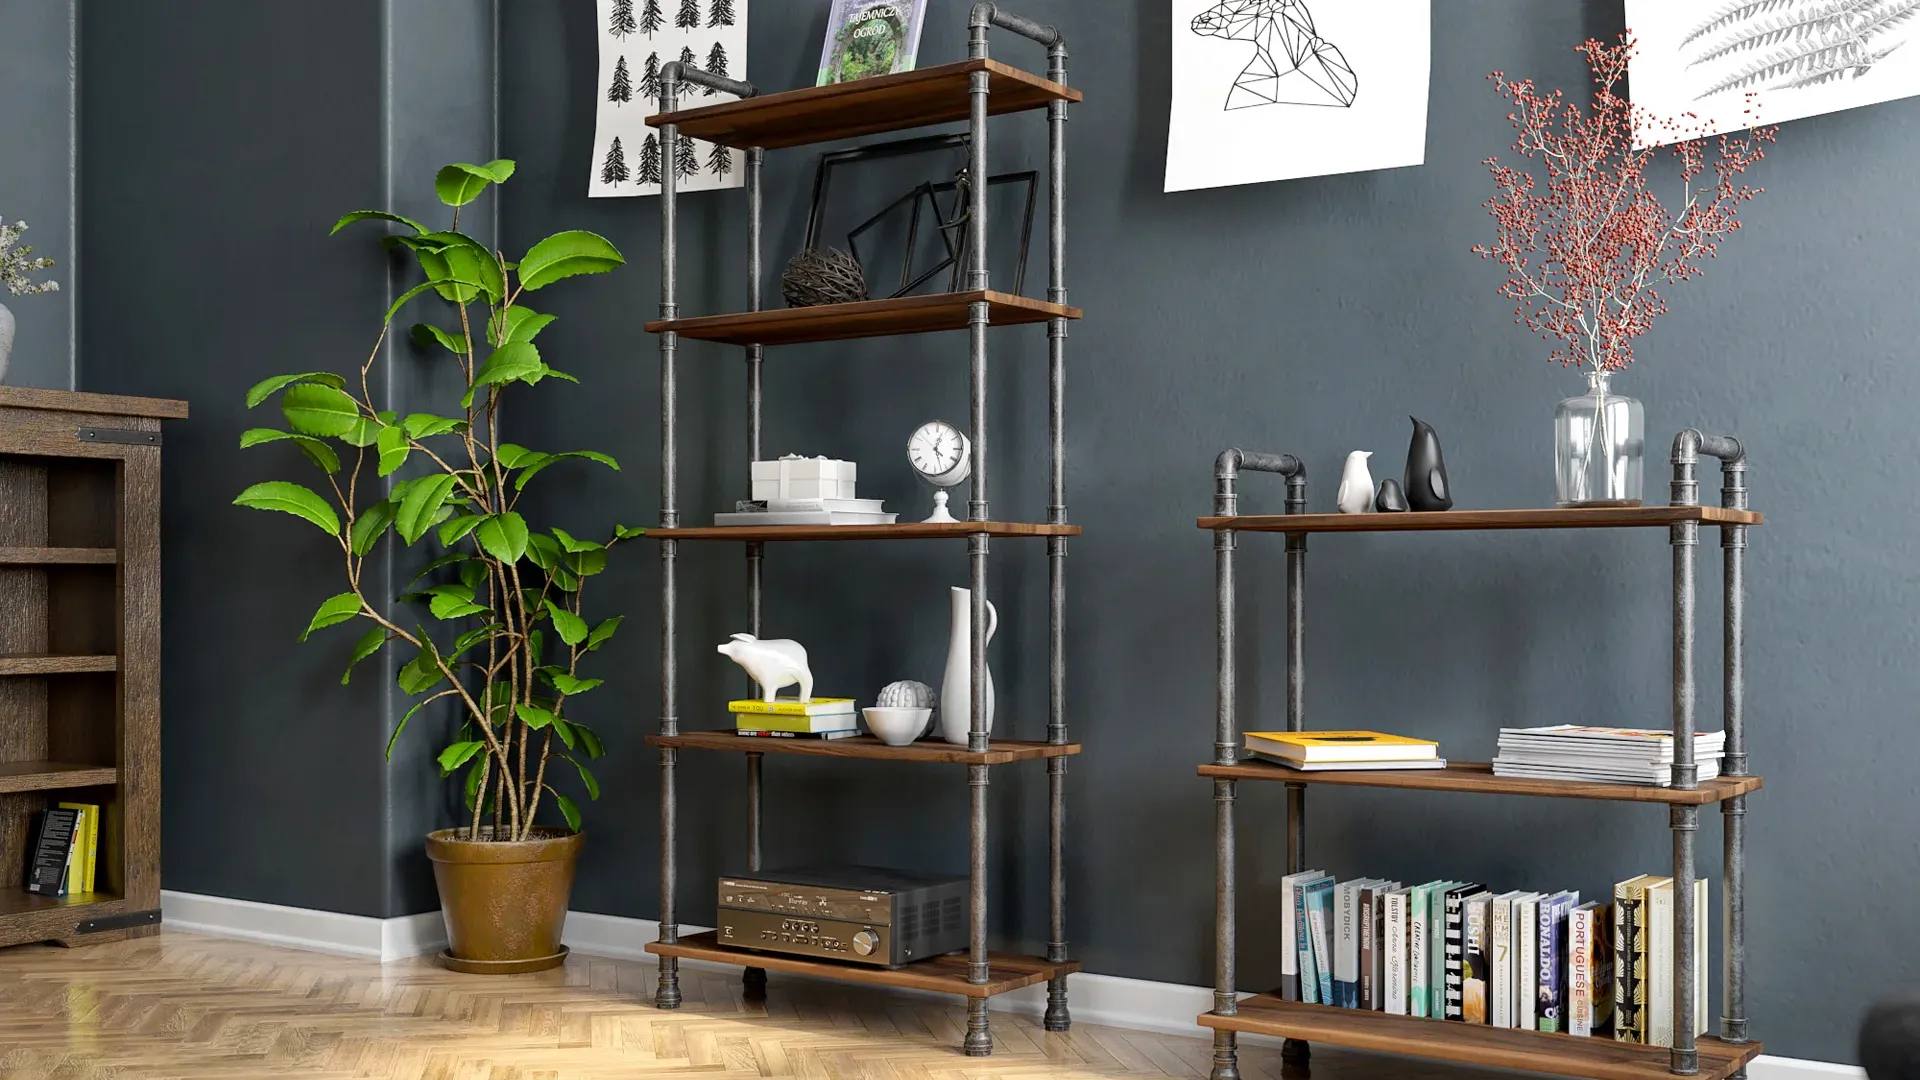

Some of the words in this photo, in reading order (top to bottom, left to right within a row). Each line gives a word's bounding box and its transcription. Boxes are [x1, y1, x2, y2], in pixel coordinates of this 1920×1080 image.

[849, 6, 900, 24] TAJEMNICZY
[1343, 886, 1351, 940] MOBYDICK
[1391, 897, 1399, 922] TOLSTOY
[1493, 914, 1509, 923] ME
[1391, 925, 1399, 954] Anna
[1413, 920, 1422, 950] CREATIVE
[1467, 900, 1481, 955] SUSHI
[1540, 901, 1552, 980] RONALDO
[1496, 944, 1508, 962] 7
[1576, 912, 1585, 996] PORTUGUESE
[1390, 955, 1398, 1001] Karenina
[1576, 1000, 1584, 1032] CUISINE
